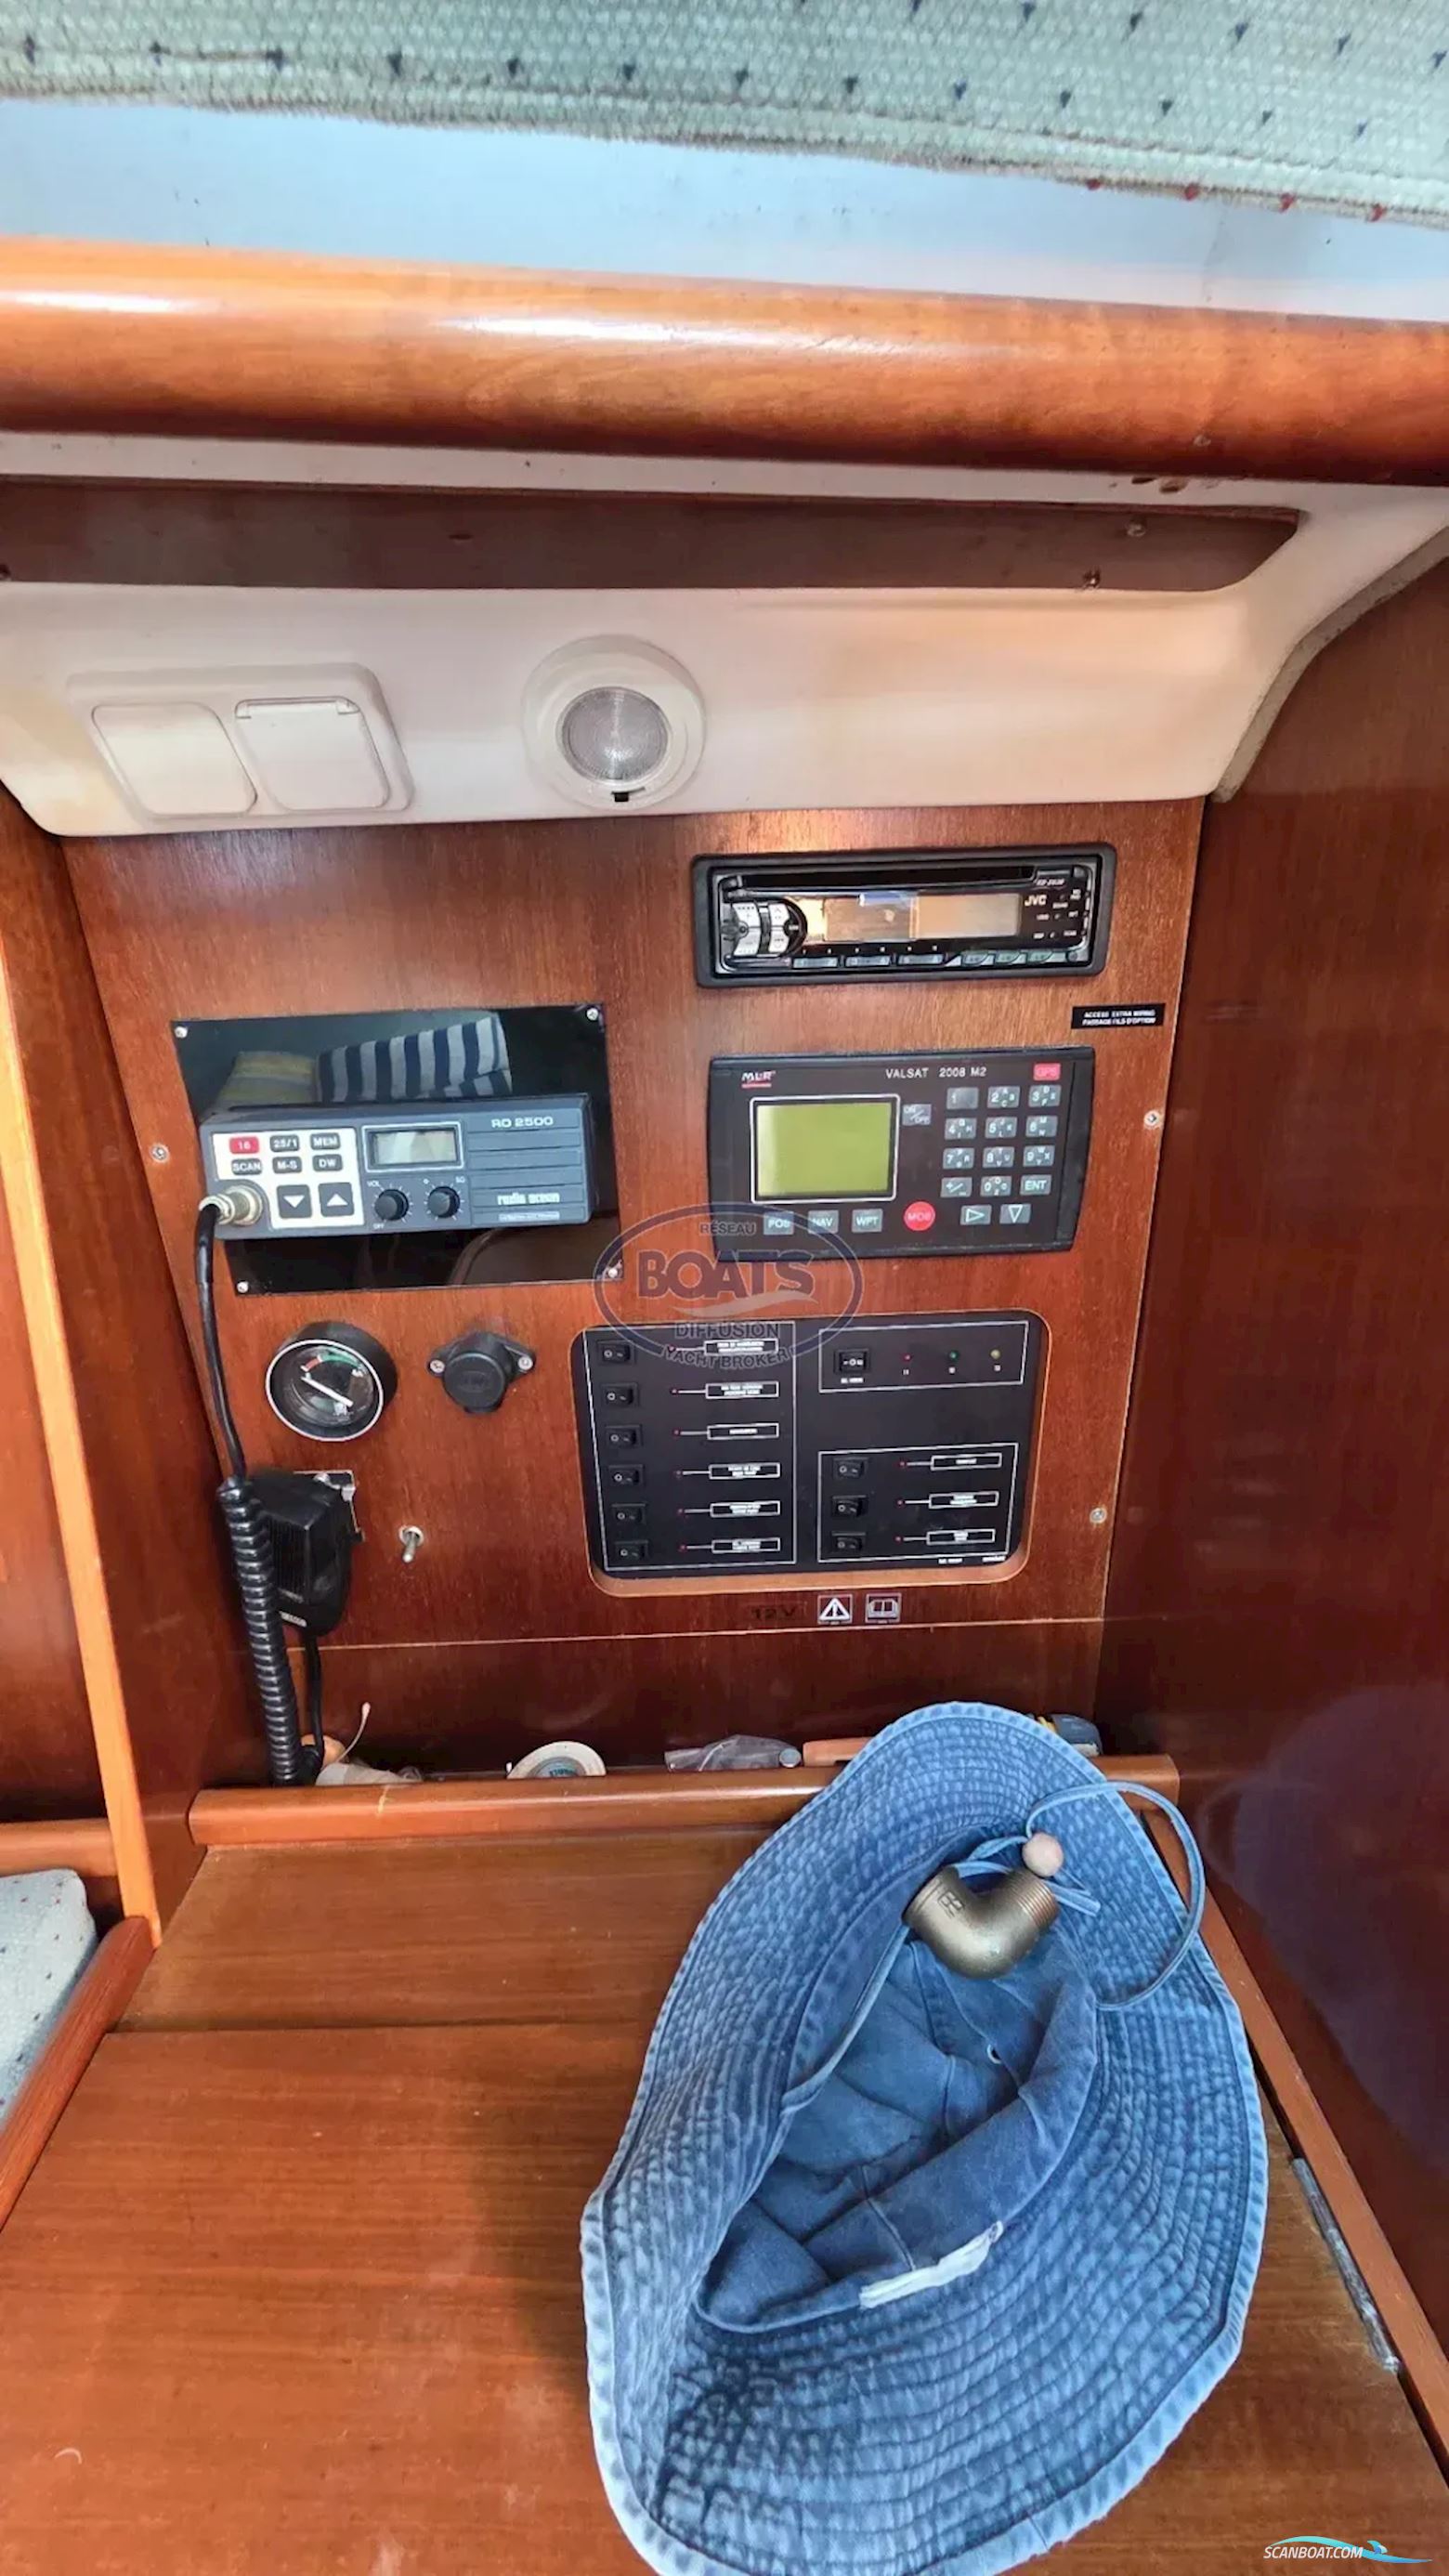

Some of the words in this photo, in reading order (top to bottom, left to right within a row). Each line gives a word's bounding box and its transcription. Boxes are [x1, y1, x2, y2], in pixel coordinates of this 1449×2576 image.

[1025, 895, 1047, 906] JVC
[885, 1068, 929, 1079] VALSAT
[939, 1067, 965, 1078] 2008
[971, 1067, 986, 1077] M2
[991, 1093, 999, 1102] 2
[1032, 1092, 1039, 1101] 3
[515, 1117, 554, 1127] 2500
[949, 1125, 955, 1133] 4
[238, 1142, 251, 1150] 16
[233, 1162, 261, 1171] SCAN
[277, 1160, 297, 1170] M-S
[319, 1158, 336, 1168] DW
[946, 1155, 953, 1164] 7
[1025, 1180, 1047, 1190] ENT
[812, 1218, 833, 1226] NAV
[856, 1217, 879, 1227] WPT
